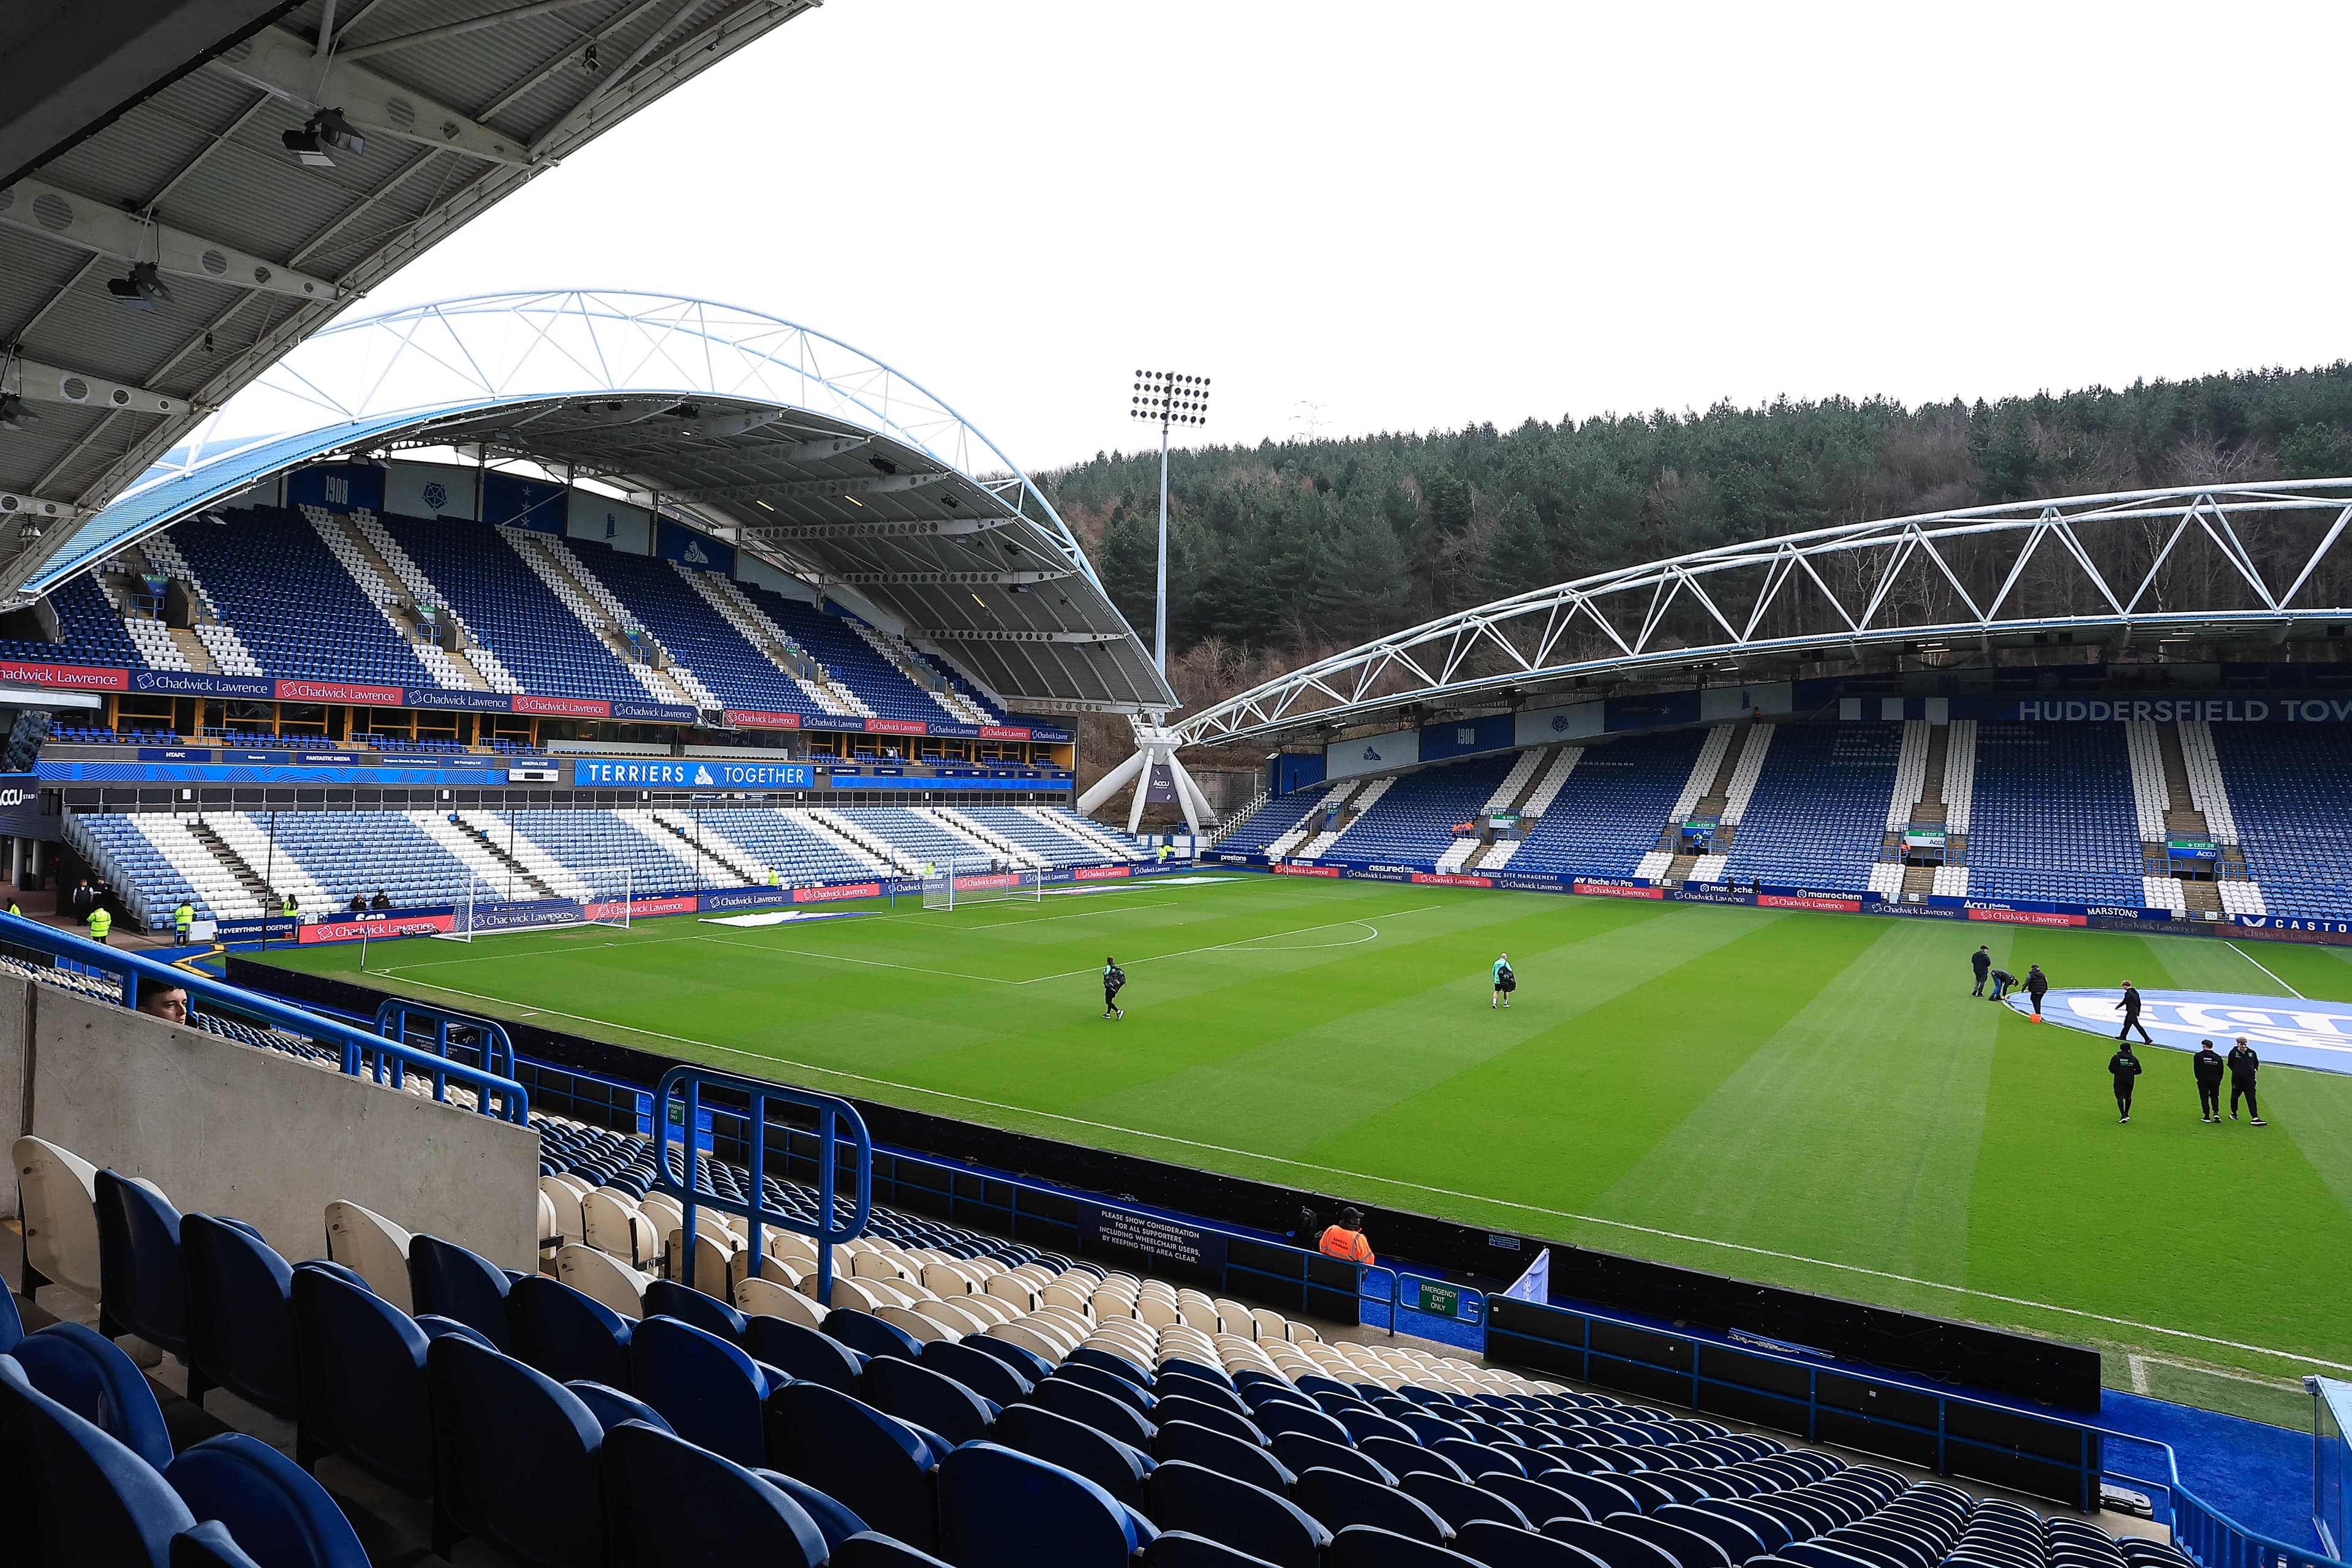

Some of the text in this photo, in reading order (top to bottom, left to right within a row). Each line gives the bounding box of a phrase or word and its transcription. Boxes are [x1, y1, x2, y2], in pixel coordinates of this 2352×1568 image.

[325, 476, 349, 505] 1908
[0, 666, 118, 685] hadwick Lawrence
[156, 676, 268, 694] Chadwick Lawrence
[298, 685, 394, 701] Chadwick Lawrence
[423, 693, 507, 708] Chadwick Lawrence
[530, 699, 604, 714] Chadwick Lawrence
[625, 706, 692, 720] Chadwick Lawrence
[2019, 701, 2269, 722] HUDDERSFIELD
[737, 712, 795, 725] Chadwick Lawrence
[811, 717, 863, 729] Chadwick Lawrence
[876, 722, 922, 733] Chadwick Lawrence
[935, 725, 957, 734] Chadwick
[989, 729, 1008, 737] Chadwick
[1038, 731, 1055, 740] Chadwick
[1458, 728, 1475, 745] 1908
[589, 764, 805, 783] TERRIERS TOGETHER
[1221, 854, 1247, 863] prestons
[1355, 870, 1378, 879] Chadwick
[1369, 865, 1404, 873] assured
[968, 878, 989, 886] Chadwick
[1428, 876, 1453, 885] Chadwick
[1518, 873, 1558, 882] MANAGEMENT
[897, 882, 922, 892] Chadwick
[1510, 881, 1536, 890] Chadwick
[1593, 886, 1621, 895] Chadwick
[813, 888, 868, 899] Chadwick Lawrence
[1684, 892, 1714, 901] Chadwick
[1808, 891, 1862, 900] manrochem
[722, 895, 783, 907] Chadwick Lawrence
[1779, 899, 1811, 908] Chadwick
[1963, 899, 1992, 910] ACCU
[611, 903, 683, 915] Chawick Lawrence
[1883, 905, 1954, 918] Chadwick Lawrence
[2087, 908, 2138, 919] MARSTONS
[532, 912, 570, 923] Lawrence
[1993, 911, 2068, 925] Chadwick Lawrence
[388, 921, 434, 933] Lawrence
[2115, 921, 2197, 934] Chadwick Lawrence
[2275, 919, 2347, 933] CASTO
[2244, 929, 2332, 943] Chadwick Lawrence
[1101, 1210, 1200, 1238] PLEASE SHOW CONSIDERATION
[1115, 1222, 1184, 1244] FOR ALL SUPPORTERS,
[1099, 1226, 1200, 1257] INCLUDING WHEELCHAIR USERS,
[1112, 1237, 1138, 1248] KEEPING
[1140, 1244, 1155, 1253] THIS
[1156, 1248, 1173, 1257] AREA
[1175, 1253, 1197, 1264] CLEAR.
[1421, 1284, 1457, 1298] EMERGENCY
[1432, 1295, 1445, 1303] EXIT
[1431, 1302, 1446, 1311] ONLY
